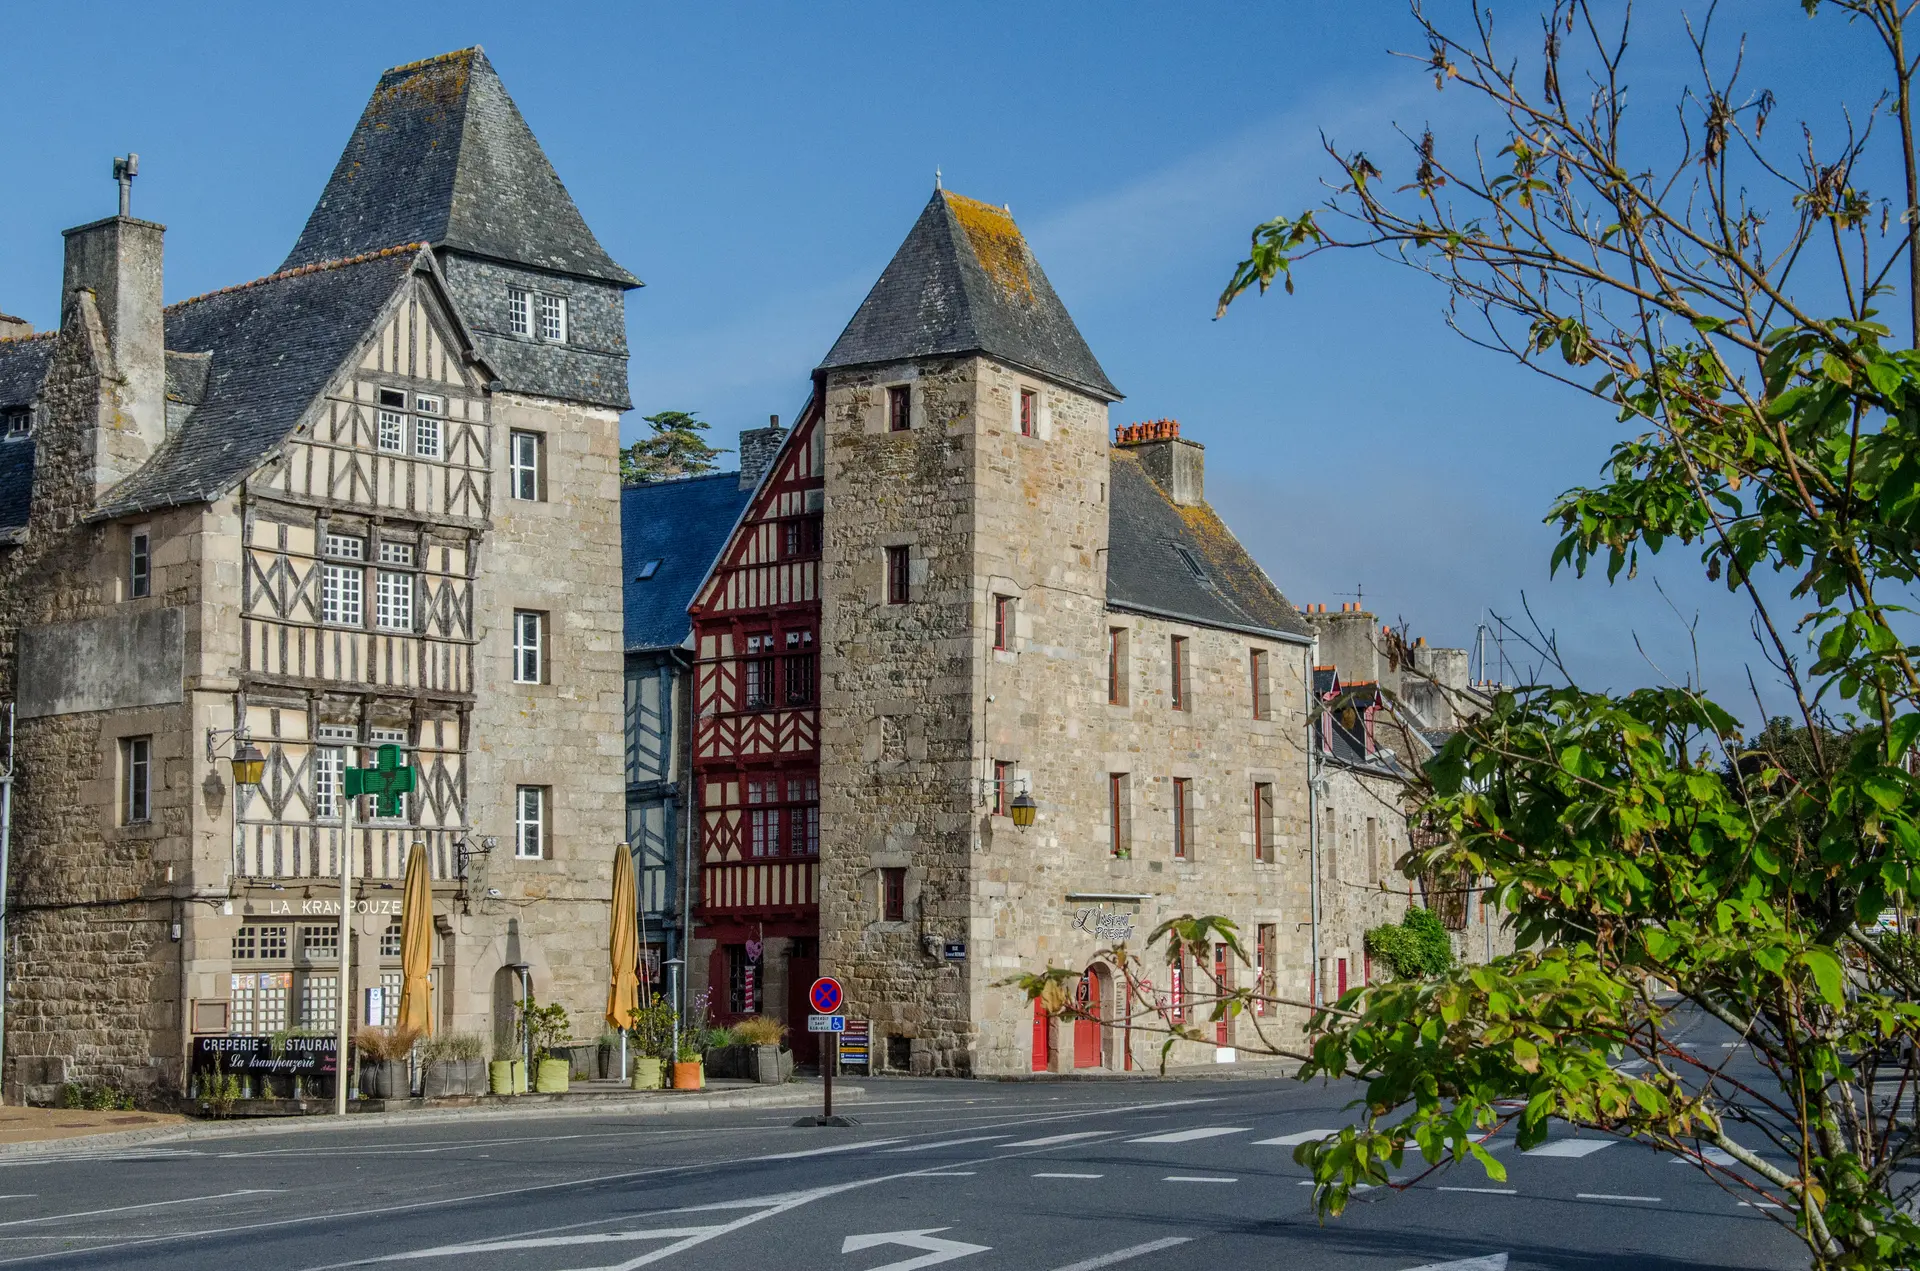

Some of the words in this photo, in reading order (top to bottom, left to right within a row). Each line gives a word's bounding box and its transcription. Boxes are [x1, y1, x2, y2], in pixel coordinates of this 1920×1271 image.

[270, 900, 291, 914] LA
[203, 1039, 259, 1051] CREPERIE
[271, 1038, 337, 1051] ESTAURAN
[229, 1053, 245, 1068] La
[249, 1054, 315, 1073] krampouzerie
